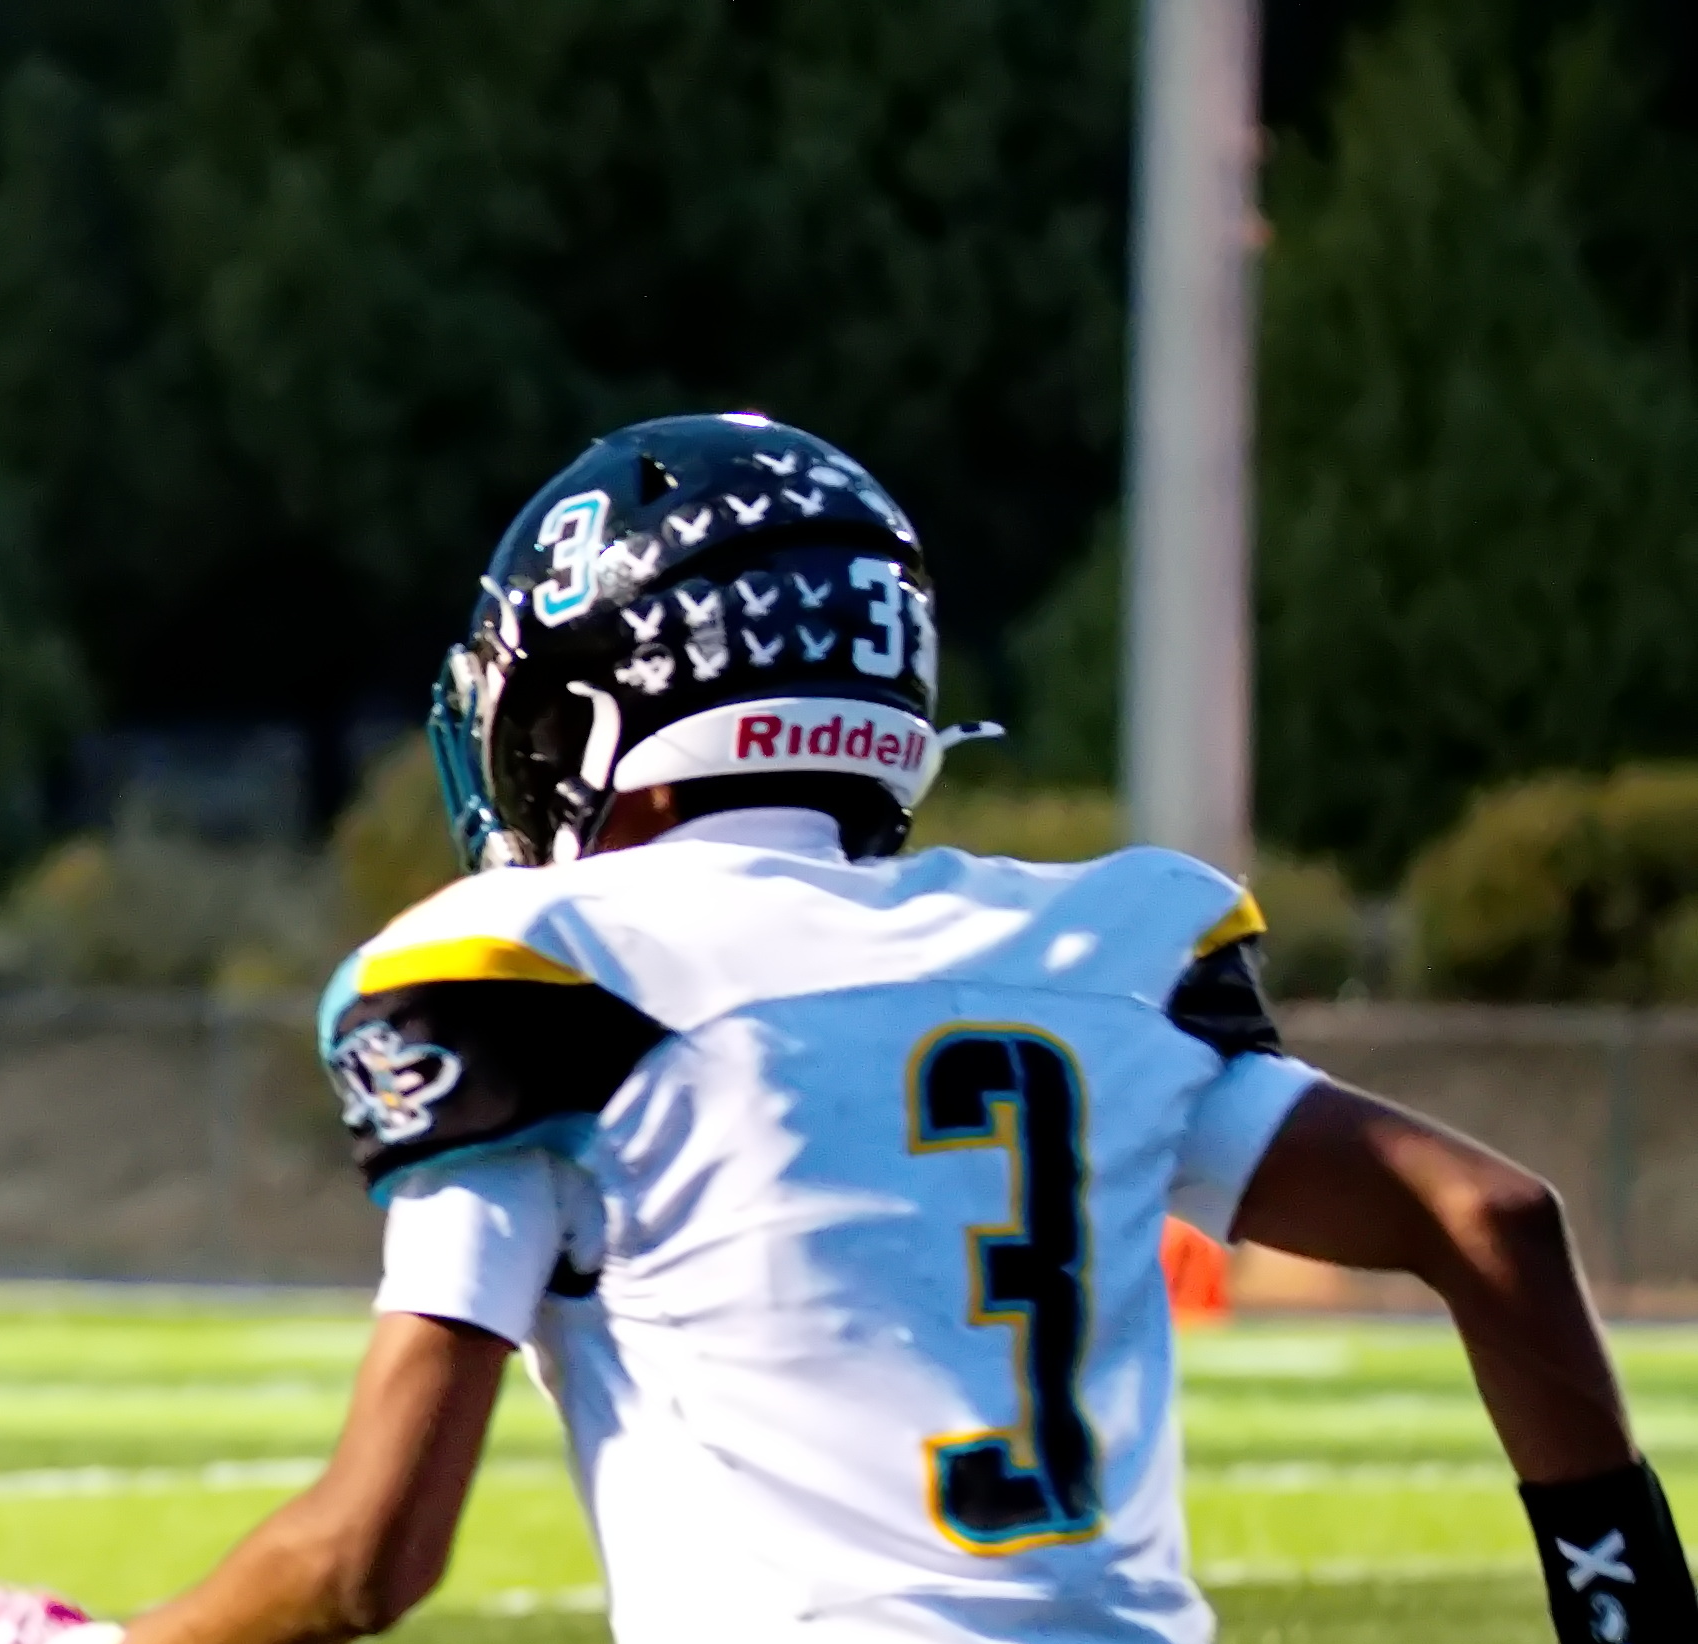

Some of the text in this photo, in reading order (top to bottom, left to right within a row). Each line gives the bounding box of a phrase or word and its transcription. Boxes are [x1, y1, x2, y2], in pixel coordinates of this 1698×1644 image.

[532, 489, 610, 628] 3
[848, 557, 905, 680] 3
[736, 714, 927, 771] Riddell
[906, 1020, 1104, 1556] 3
